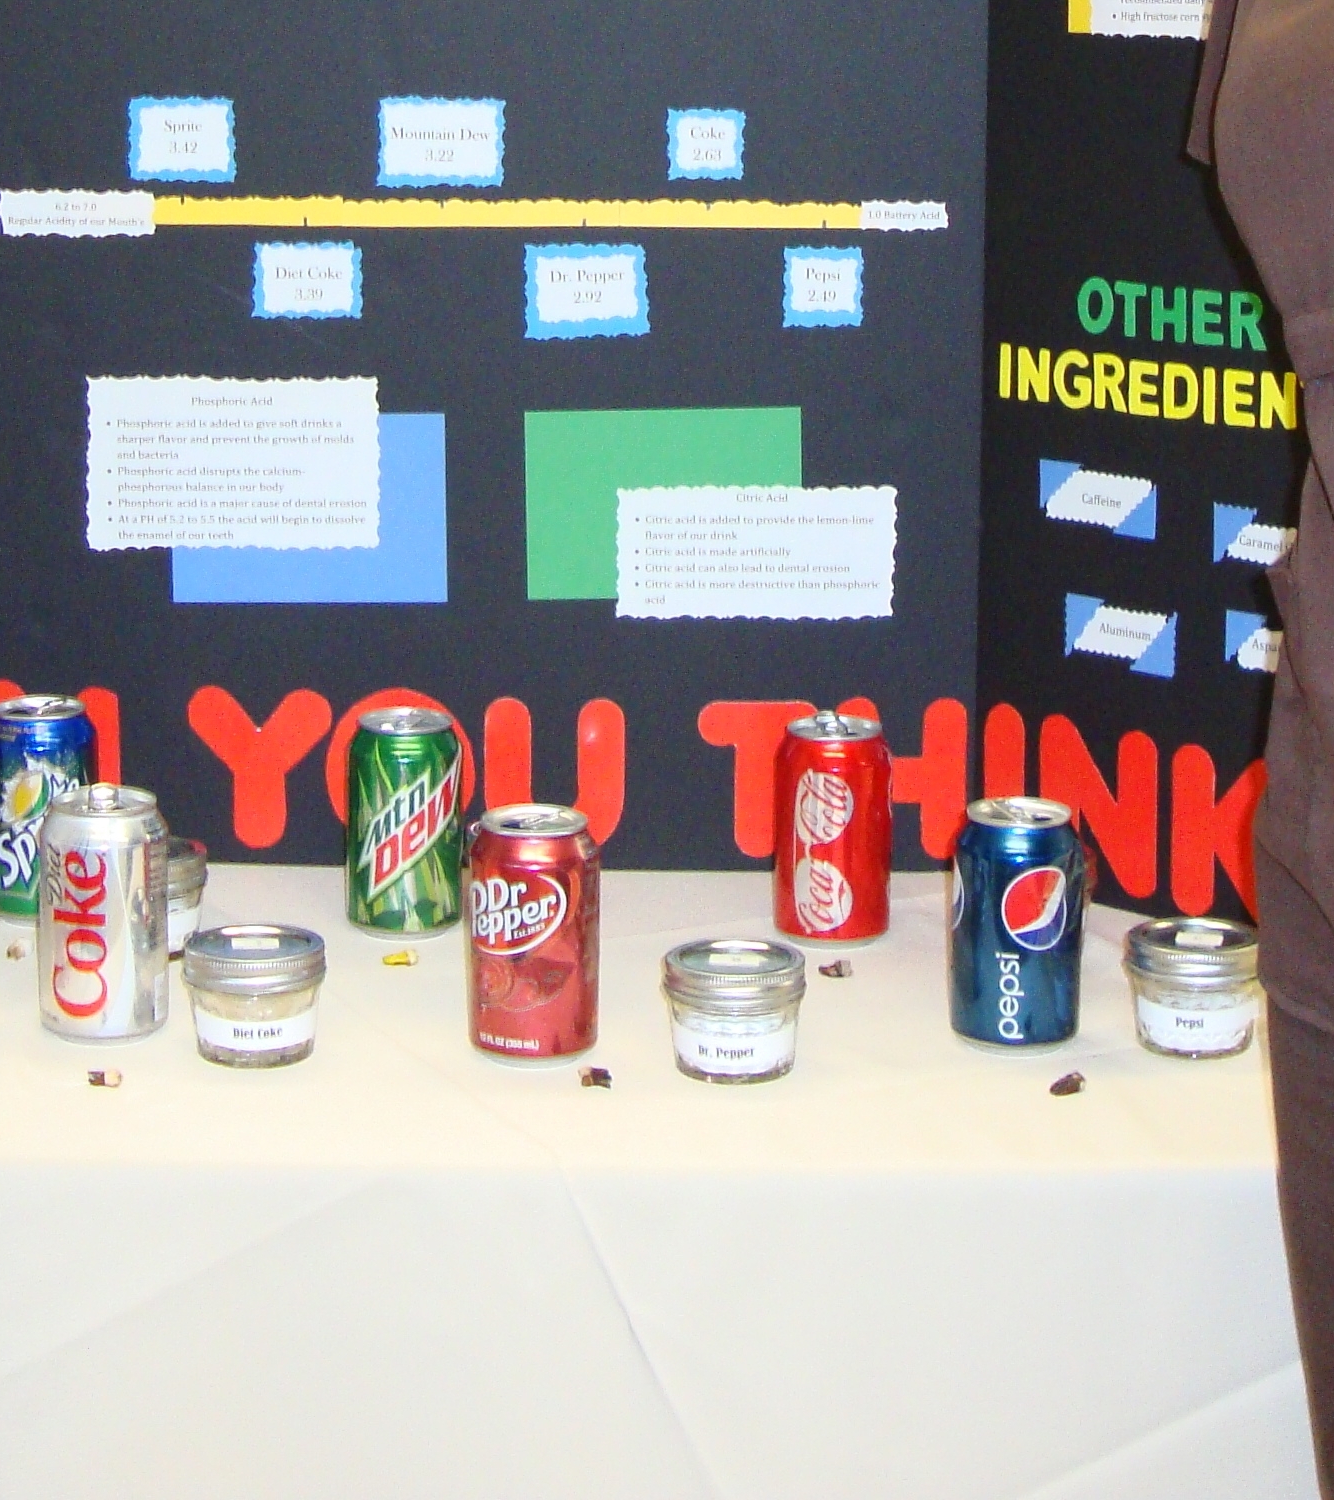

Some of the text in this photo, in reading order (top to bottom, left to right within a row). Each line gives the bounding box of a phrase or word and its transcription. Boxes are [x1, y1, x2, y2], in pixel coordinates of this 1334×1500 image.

[164, 119, 203, 134] Sprite
[391, 126, 491, 141] Mountain Dew
[690, 126, 726, 140] Coke
[276, 266, 342, 280] Diet Coke
[577, 269, 625, 285] Pepper
[805, 268, 841, 284] Pepsi
[1077, 276, 1267, 352] OTHER
[999, 342, 1303, 430] INGREDIEN
[736, 493, 788, 503] Citric Acid
[1082, 493, 1122, 510] Caffeine
[1239, 534, 1283, 551] Caramel
[1099, 623, 1152, 642] Aluminum
[698, 696, 1266, 924] THINK
[53, 850, 108, 1018] Coke
[995, 952, 1025, 1040] pepsi
[1175, 1016, 1205, 1030] Pepsi
[715, 1047, 755, 1060] Pepper
